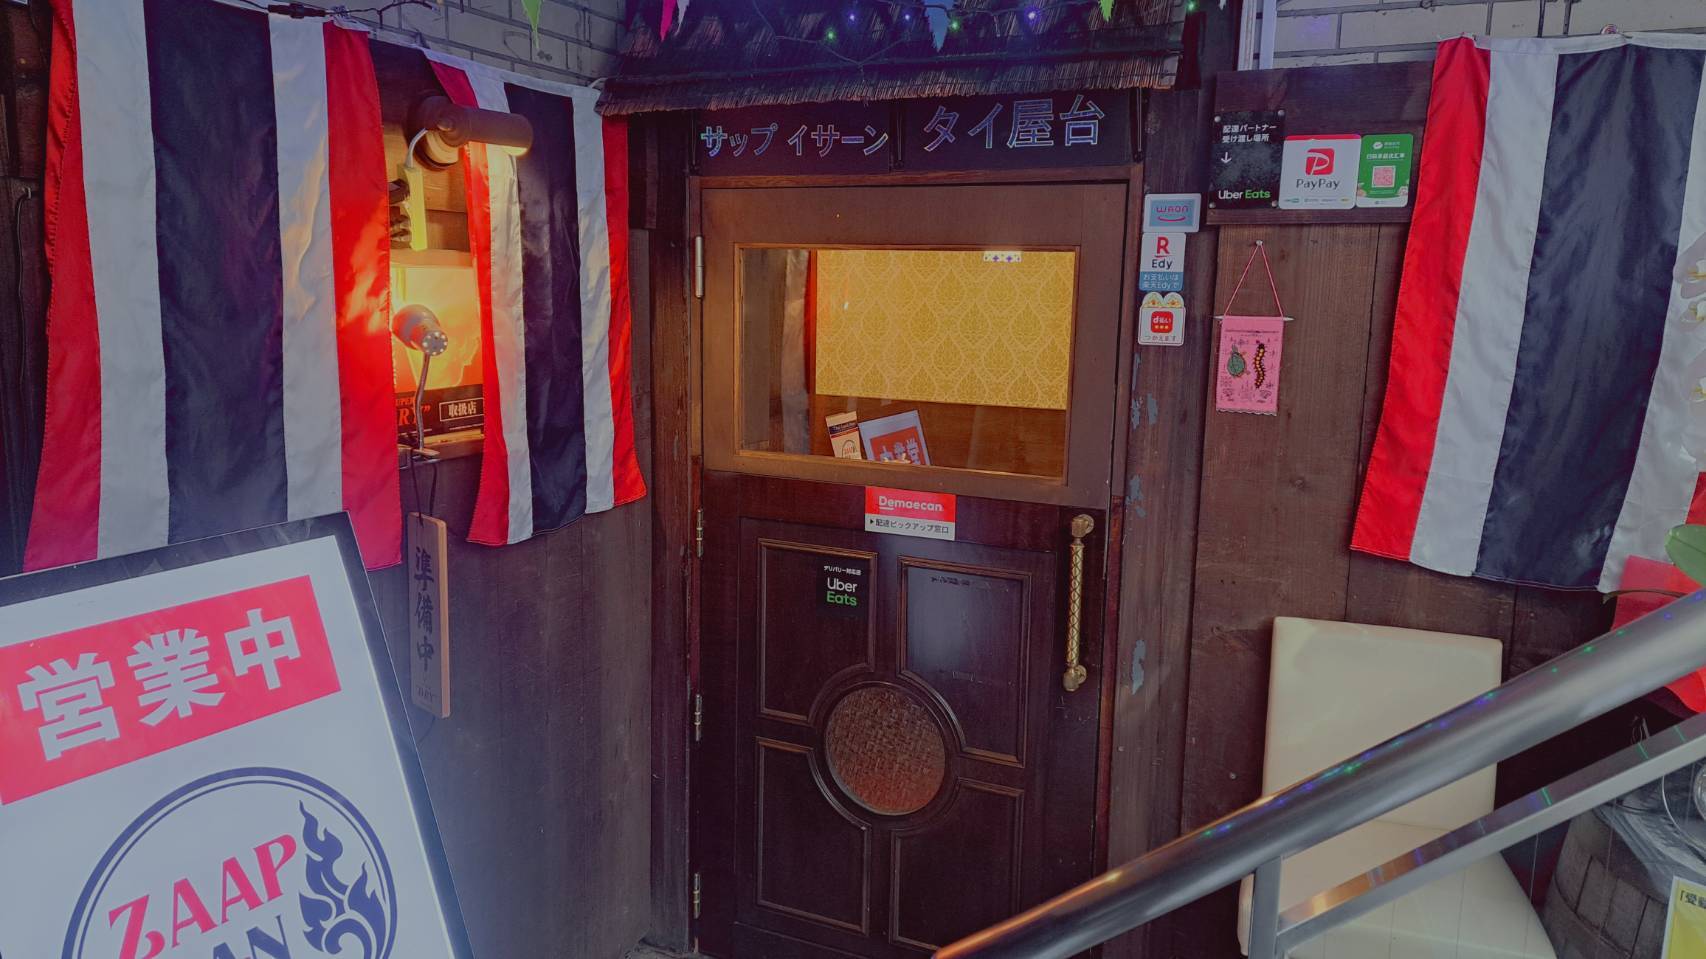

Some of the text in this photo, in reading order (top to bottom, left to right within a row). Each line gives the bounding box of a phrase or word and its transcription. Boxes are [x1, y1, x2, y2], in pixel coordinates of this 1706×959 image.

[924, 95, 1105, 152] タイ屋台
[701, 122, 889, 157] サップ イサーン
[1296, 178, 1340, 191] PayPay
[1218, 189, 1271, 200] Uber Eats
[1156, 236, 1171, 256] R
[1151, 258, 1173, 270] Edy
[448, 401, 477, 417] 取扱店
[879, 496, 943, 511] Demaecan
[827, 577, 858, 592] Uber
[826, 590, 857, 606] Eats
[413, 547, 435, 672] 準備中
[17, 608, 301, 761] 営業中
[108, 834, 297, 959] ZAAP
